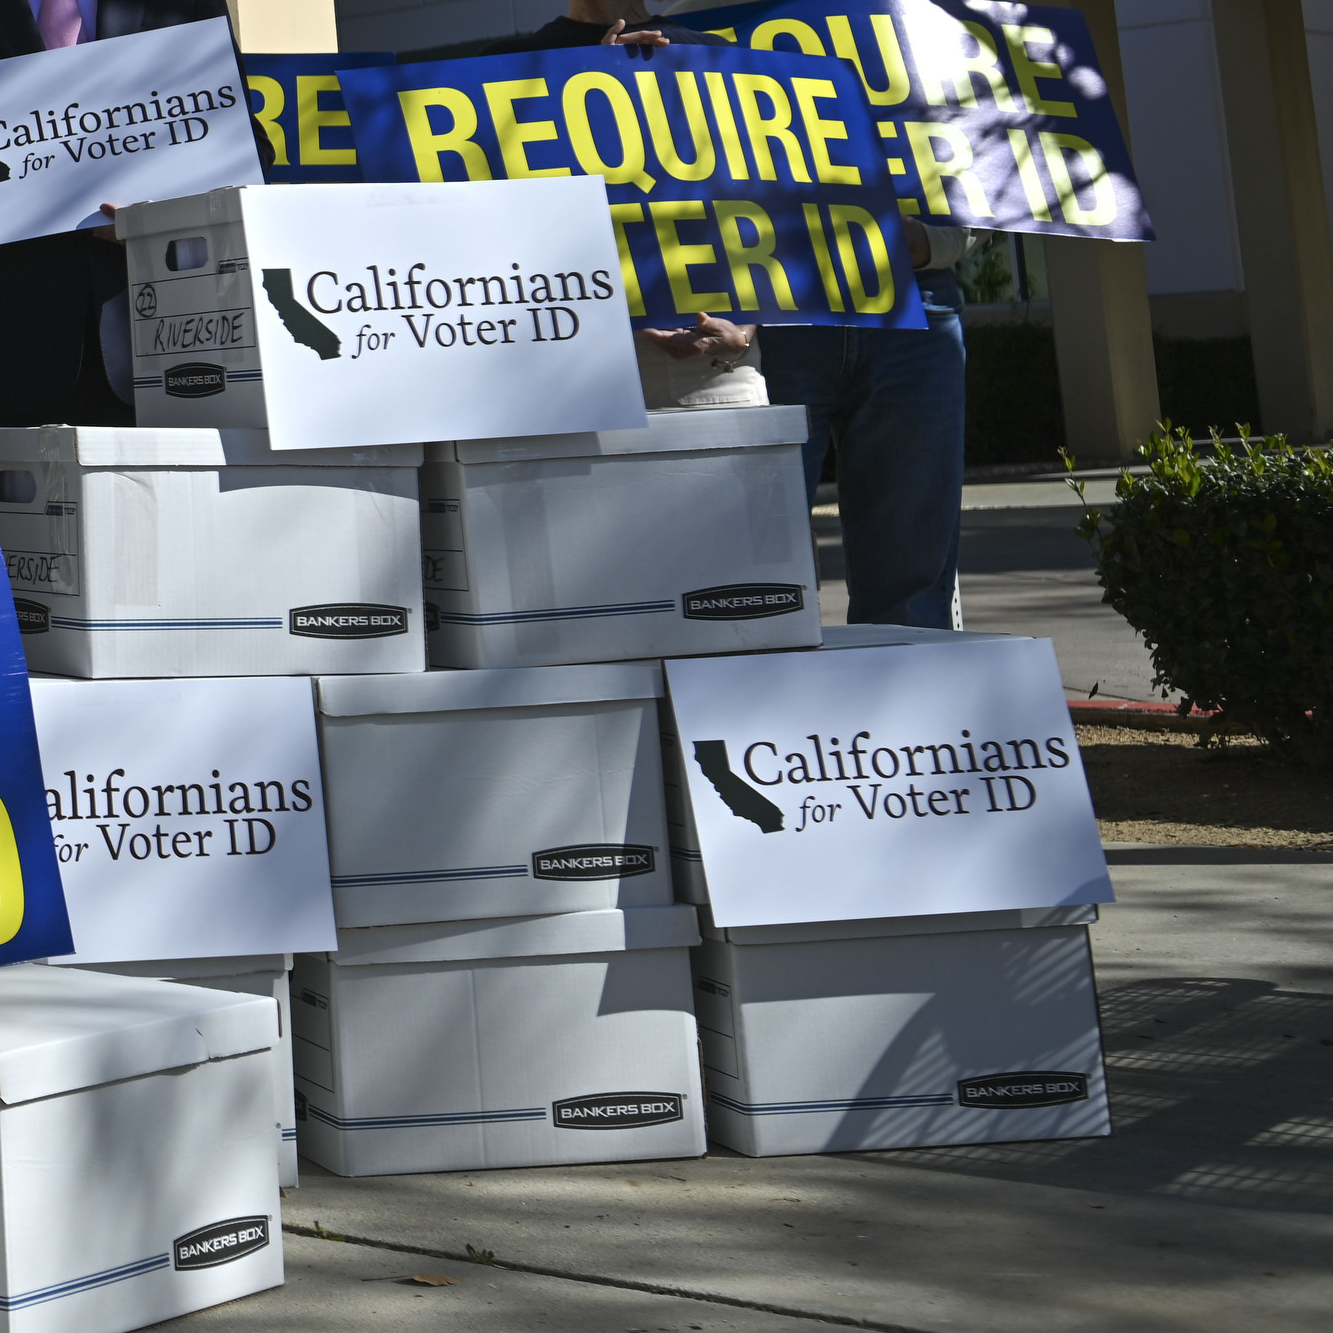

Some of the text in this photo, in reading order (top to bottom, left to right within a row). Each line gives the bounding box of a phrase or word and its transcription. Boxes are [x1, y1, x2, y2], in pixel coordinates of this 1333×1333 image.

[18, 117, 210, 180] for Voter ID
[396, 70, 863, 194] REQUIRE
[1006, 128, 1118, 226] ID
[611, 199, 896, 318] TER ID
[306, 262, 614, 315] Californians
[154, 312, 245, 352] RIVERSIDE
[351, 306, 581, 360] for Voter ID
[168, 373, 222, 387] BANKERS BOX
[5, 554, 62, 585] ERSIDE
[29, 612, 46, 624] BOX
[296, 615, 402, 627] BANKERS BOX
[690, 593, 797, 610] BANKERS BOX
[742, 729, 1071, 787] Californians
[45, 768, 313, 822] alifornians
[795, 774, 1038, 833] for Voter ID
[96, 823, 213, 861] Voter
[223, 817, 277, 856] ID
[539, 854, 648, 870] BANKERS BOX
[561, 1102, 676, 1119] BANKERS BOX
[965, 1081, 1081, 1098] BANKERS BOX
[179, 1225, 265, 1260] BANKERS BOX
